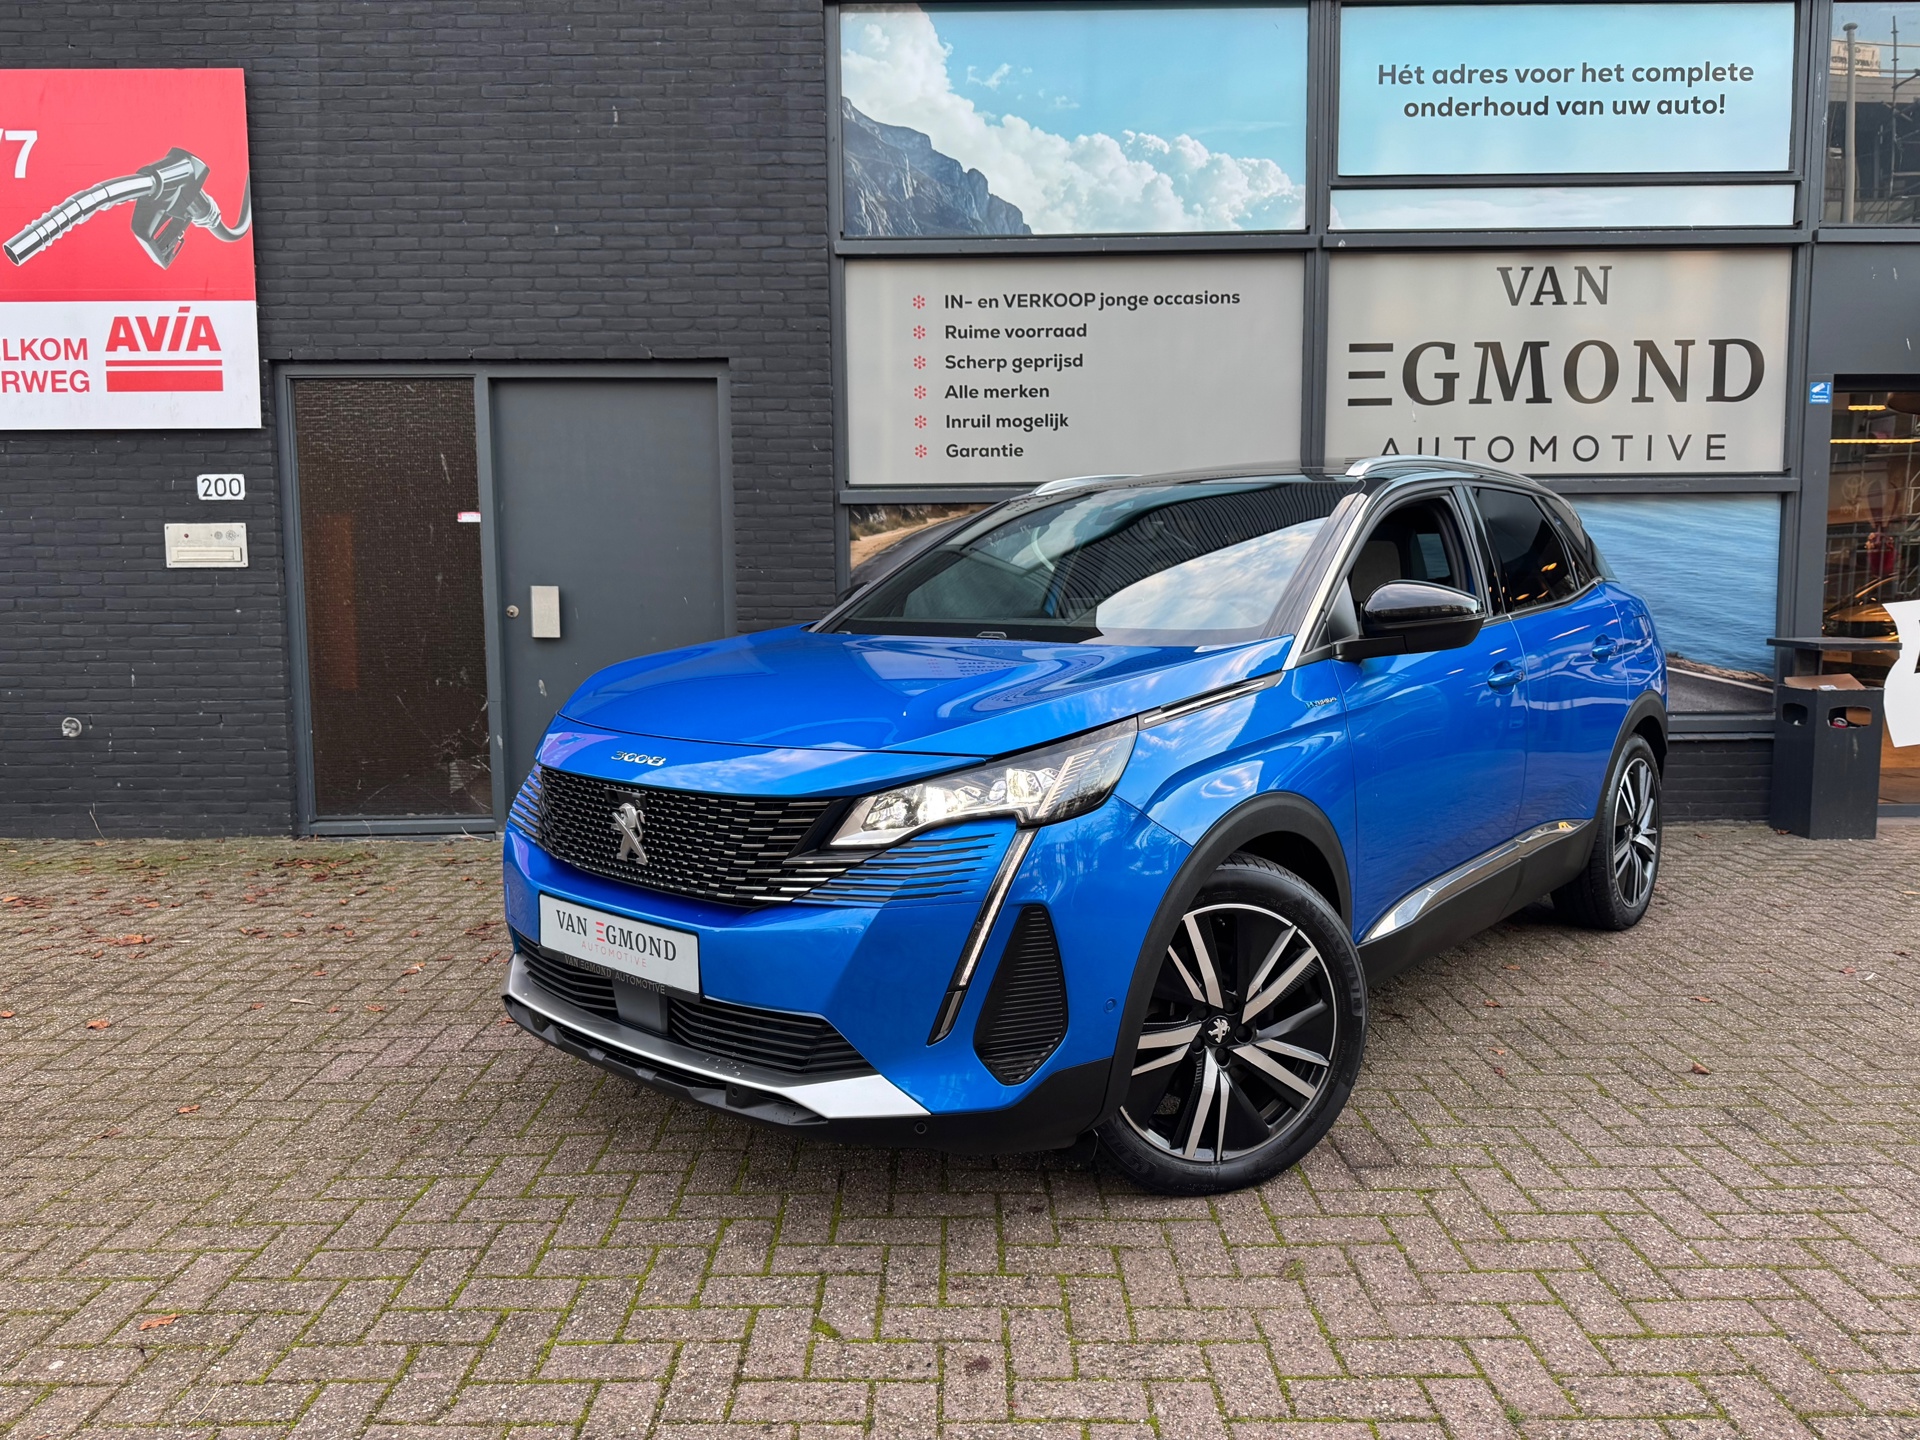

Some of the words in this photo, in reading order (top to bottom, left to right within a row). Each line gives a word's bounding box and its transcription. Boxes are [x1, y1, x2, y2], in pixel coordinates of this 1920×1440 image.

[1377, 64, 1425, 85] Hét
[1432, 63, 1508, 84] adres
[1514, 67, 1575, 84] voor
[1581, 62, 1625, 83] het
[1631, 61, 1754, 88] complete
[1403, 95, 1549, 118] onderhoud
[1556, 99, 1604, 116] van
[1612, 99, 1651, 115] uw
[1656, 93, 1726, 115] auto!
[0, 127, 39, 179] 7
[1496, 265, 1613, 307] VAN
[945, 294, 973, 309] IN-
[977, 297, 999, 309] en
[1003, 293, 1096, 309] VERKOOP
[1098, 292, 1149, 311] jonge
[1153, 290, 1241, 306] occasions
[945, 325, 1001, 339] Ruime
[1004, 323, 1087, 339] voorraad
[0, 337, 88, 361] LKOM
[945, 354, 1007, 373] Scherp
[1011, 353, 1084, 373] geprijsd
[1347, 337, 1766, 407] EGMOND
[1, 369, 90, 393] RWEG
[944, 385, 979, 399] Alle
[983, 384, 1050, 398] merken
[945, 414, 991, 429] Inruil
[996, 413, 1069, 432] mogelijk
[945, 443, 1024, 458] Garantie
[1381, 433, 1727, 463] AUTOMOTIVE
[201, 477, 242, 497] 200
[611, 750, 667, 767] 3008
[556, 909, 588, 937] VAN
[595, 921, 677, 962] EGMOND
[581, 940, 647, 968] AUTOMOTIVE
[564, 954, 579, 968] VAN
[580, 959, 612, 979] EGMOND
[614, 971, 666, 995] AUTOMOTIVE
